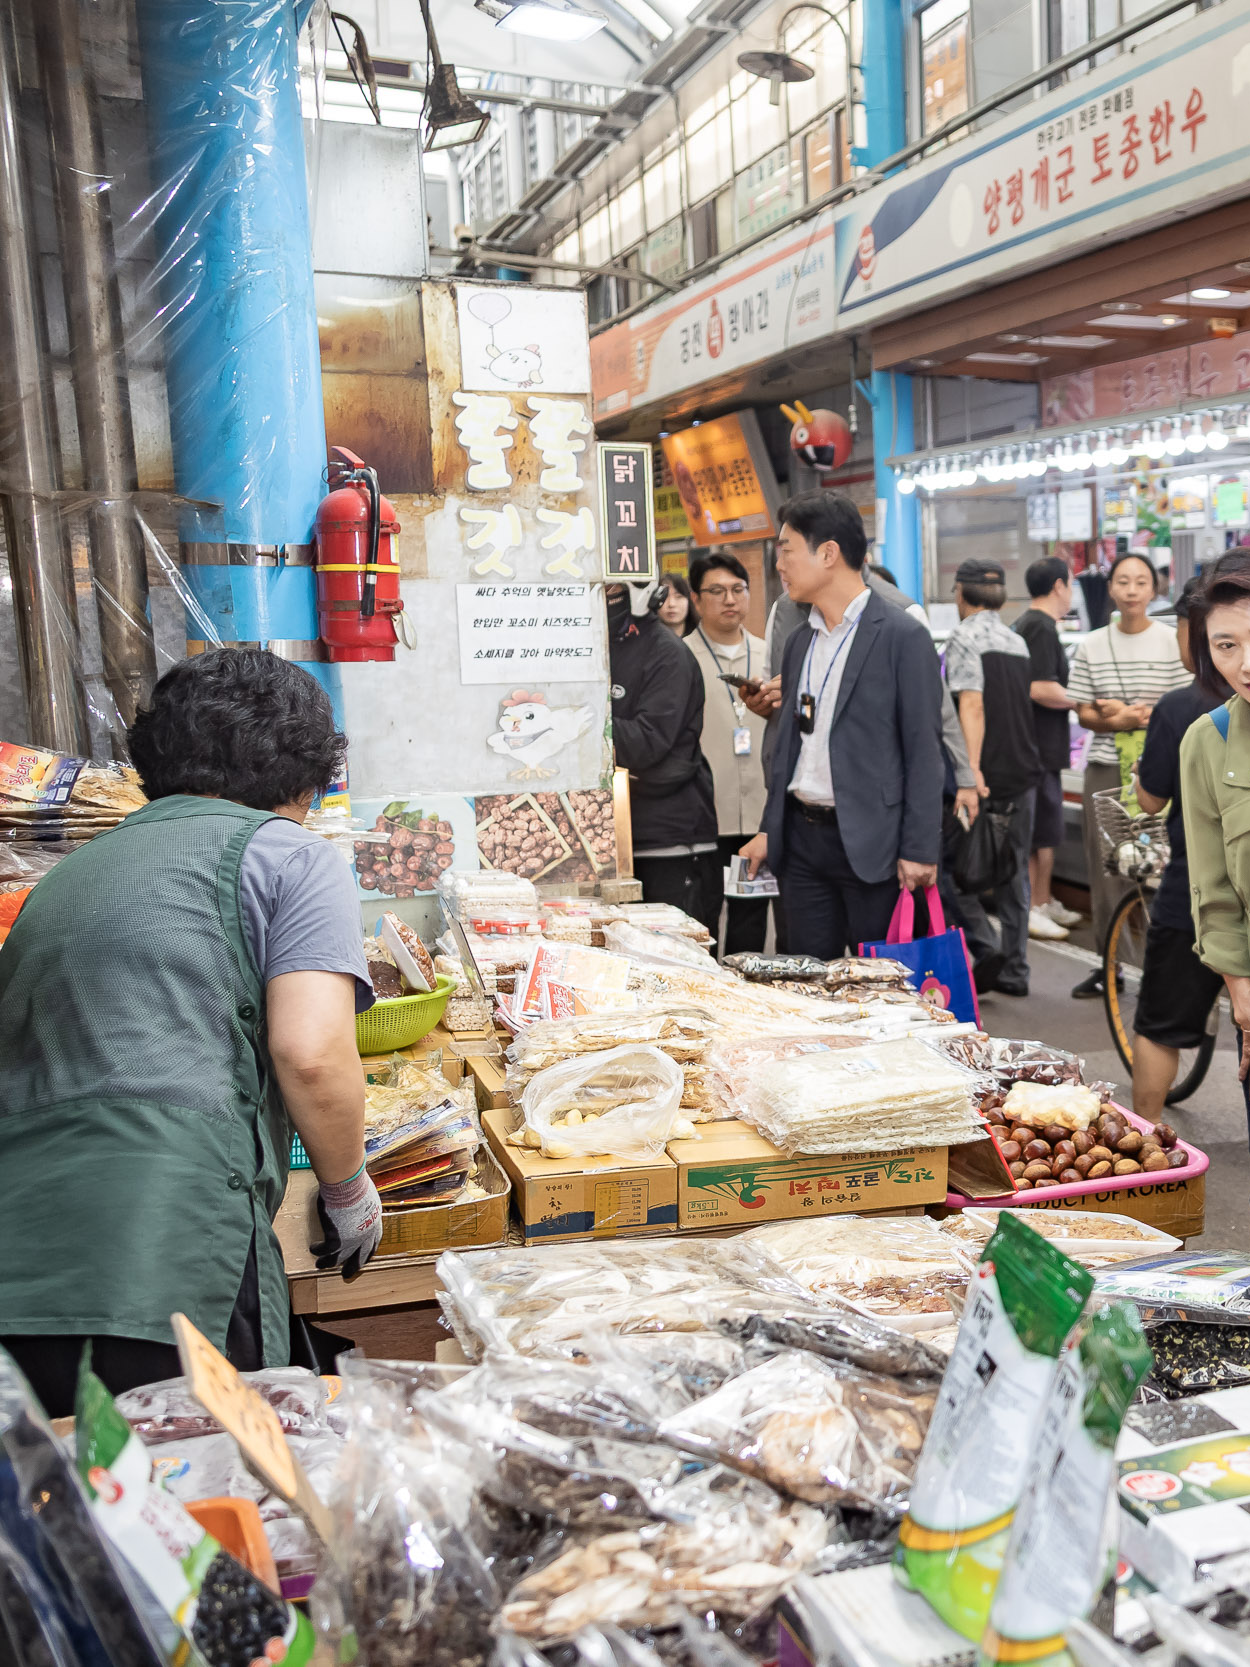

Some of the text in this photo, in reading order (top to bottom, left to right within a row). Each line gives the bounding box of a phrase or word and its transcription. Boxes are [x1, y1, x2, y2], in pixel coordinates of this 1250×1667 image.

[1079, 104, 1098, 131] 전문
[983, 87, 1208, 237] 양평개군 토종한우
[612, 454, 640, 573] 닭꼬치
[475, 587, 585, 597] 싸다 추억의 옛날핫도그
[473, 617, 592, 628] 한입만 꼬소미 치즈핫도그
[473, 647, 593, 659] 소세지를 감아 마약핫도그
[788, 1167, 935, 1197] 진도 굴포 멸치
[1095, 1187, 1121, 1202] OF
[1127, 1179, 1188, 1198] KOREA
